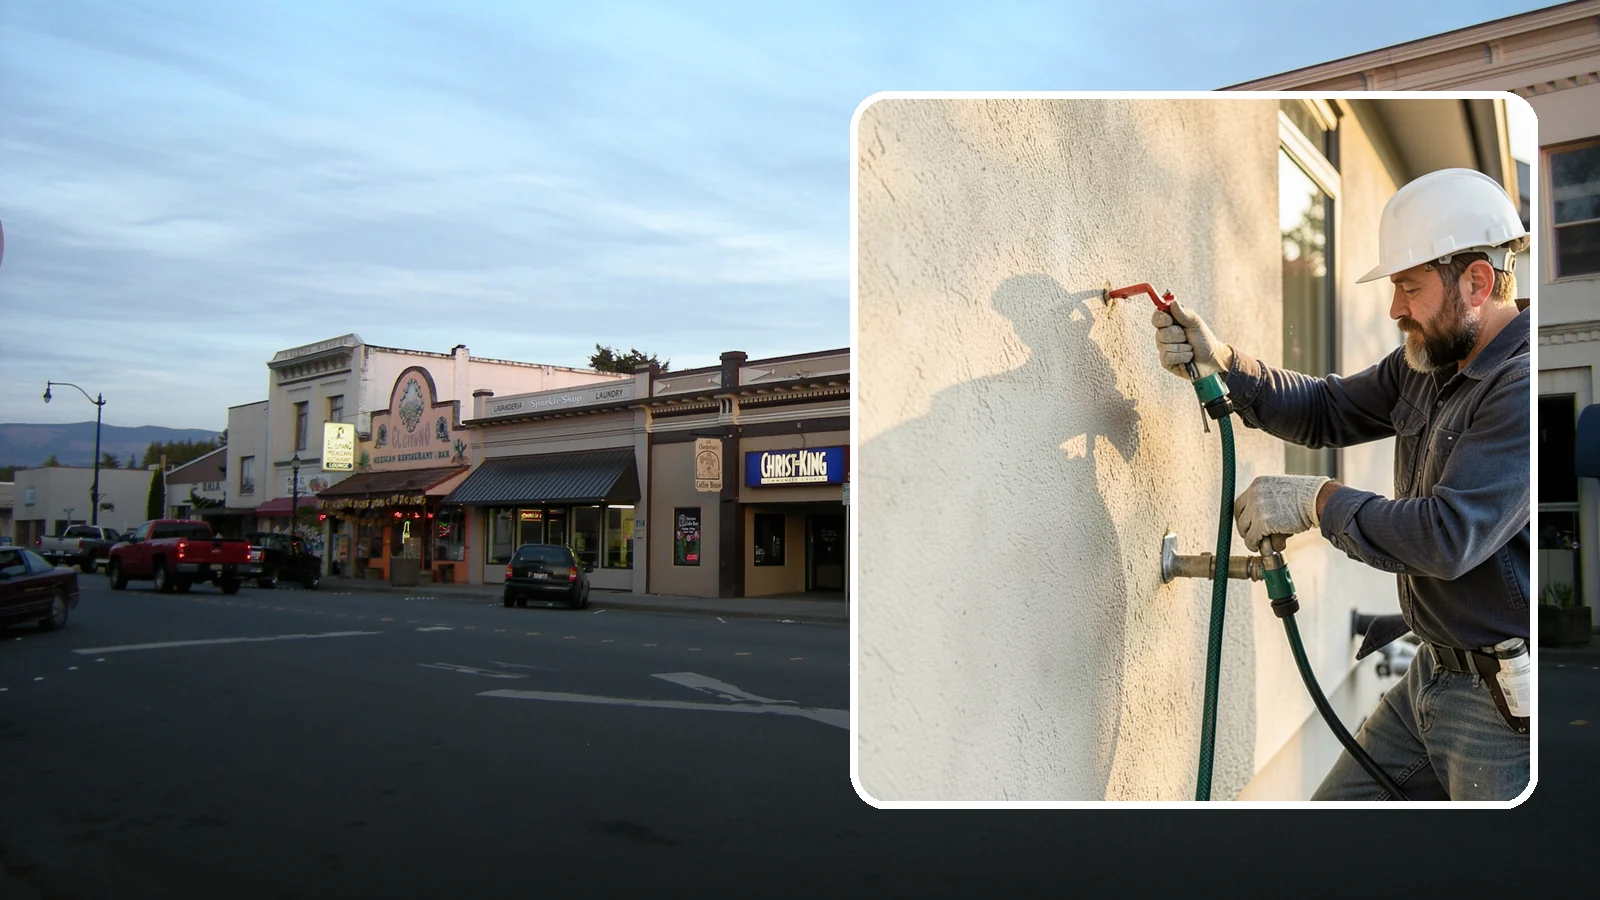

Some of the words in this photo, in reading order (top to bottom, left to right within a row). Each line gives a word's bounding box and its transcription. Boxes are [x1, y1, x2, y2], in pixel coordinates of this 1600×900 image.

[531, 398, 560, 408] Sparkle
[562, 394, 582, 404] Shop
[595, 389, 623, 400] LAUNDRY
[493, 402, 522, 412] LAVANDERIA
[373, 453, 396, 464] MEXICAN
[398, 451, 433, 462] RESTAURANT
[438, 450, 450, 459] BAR
[761, 452, 797, 478] CHRIST
[799, 450, 827, 476] KING
